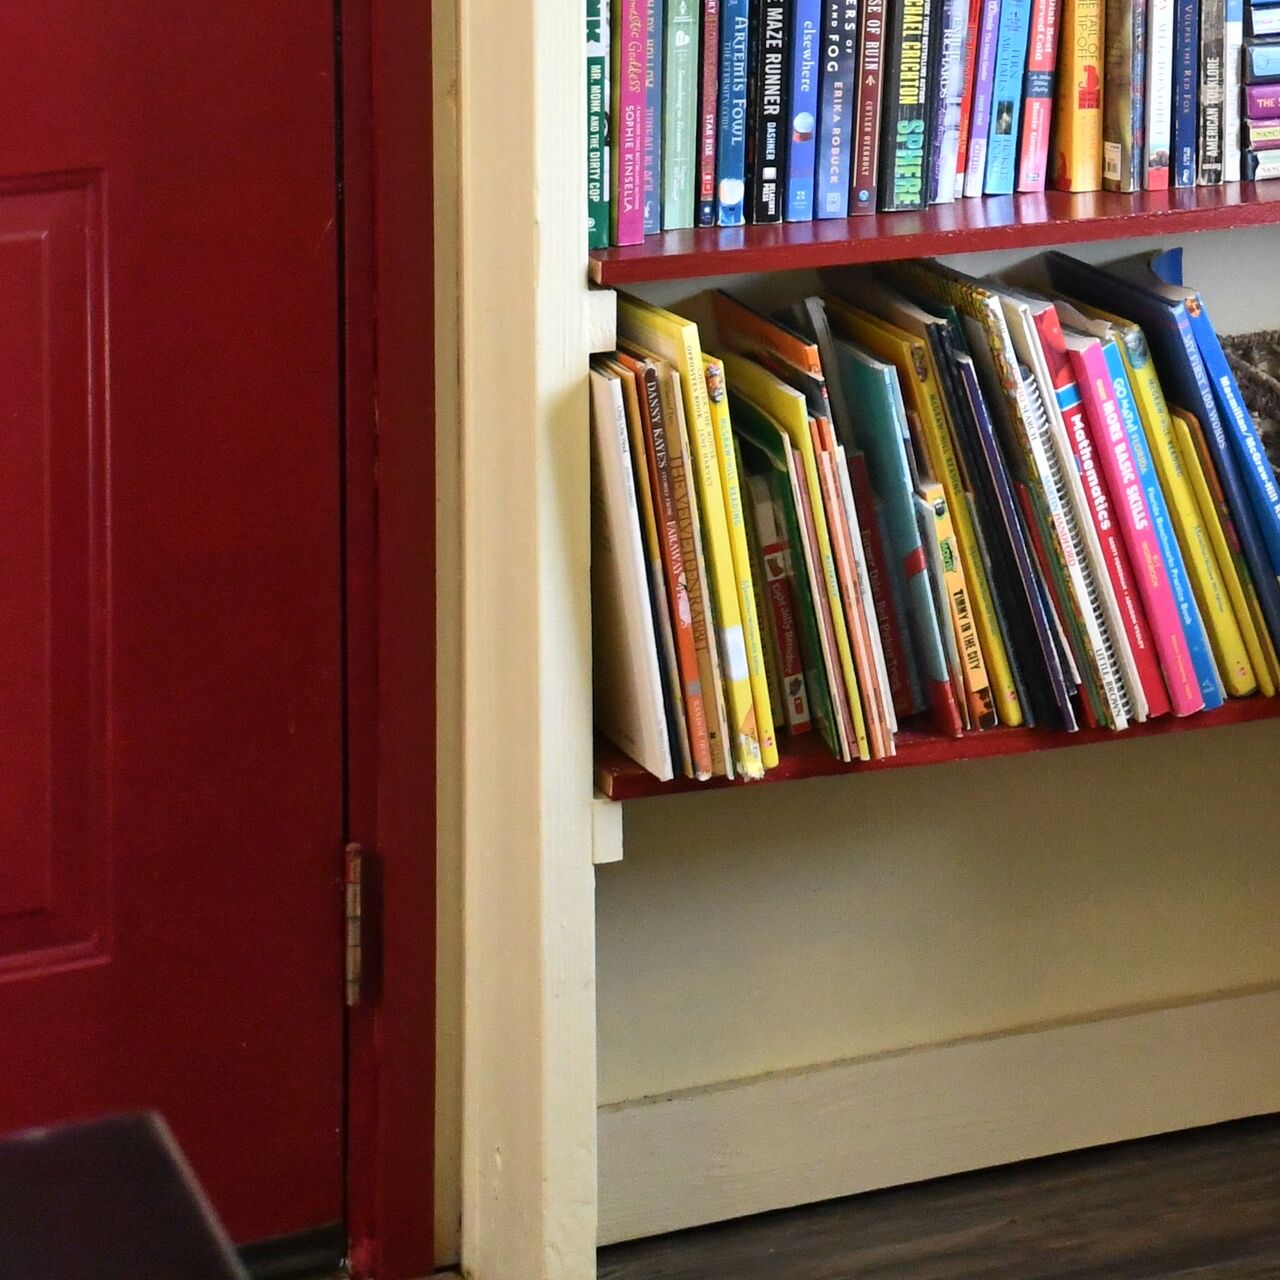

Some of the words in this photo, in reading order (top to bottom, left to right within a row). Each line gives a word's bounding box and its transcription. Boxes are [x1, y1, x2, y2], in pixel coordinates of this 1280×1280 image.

[766, 8, 783, 50] MAZE
[866, 20, 880, 35] OF
[590, 65, 600, 83] MR.
[801, 21, 815, 92] elsewhere
[865, 41, 879, 71] RUIN
[899, 41, 922, 105] CRICHTON
[590, 86, 601, 112] MONK
[764, 54, 781, 114] RUNNER
[1207, 57, 1220, 105] FOLKLORE
[731, 98, 746, 145] FOWL
[833, 82, 843, 122] ERIKA
[590, 134, 599, 149] THE
[591, 115, 599, 131] AND
[624, 106, 635, 148] SOPHIE
[766, 122, 775, 160] DASHNER
[1206, 108, 1219, 156] AMERICAN
[589, 152, 601, 182] DIRTY
[830, 127, 841, 183] ROBUCK
[896, 120, 924, 204] SPHERE
[589, 184, 600, 202] COP
[624, 152, 635, 212] KINSELLA
[1182, 334, 1195, 353] MY
[1186, 356, 1205, 386] FIRST
[1200, 388, 1215, 408] 100
[1102, 400, 1125, 442] MORE
[1206, 411, 1226, 450] WORDS
[1219, 376, 1278, 501] Macmillan/McGraw-Hill
[646, 382, 662, 422] DANNY
[666, 521, 682, 575] FARAWAY
[1070, 414, 1113, 530] Mathematics
[1114, 444, 1137, 485] BASIC
[1125, 487, 1148, 530] SKILLS
[953, 589, 968, 620] TIMMY
[960, 623, 971, 632] IN
[963, 634, 975, 650] THE
[966, 652, 981, 671] CITY
